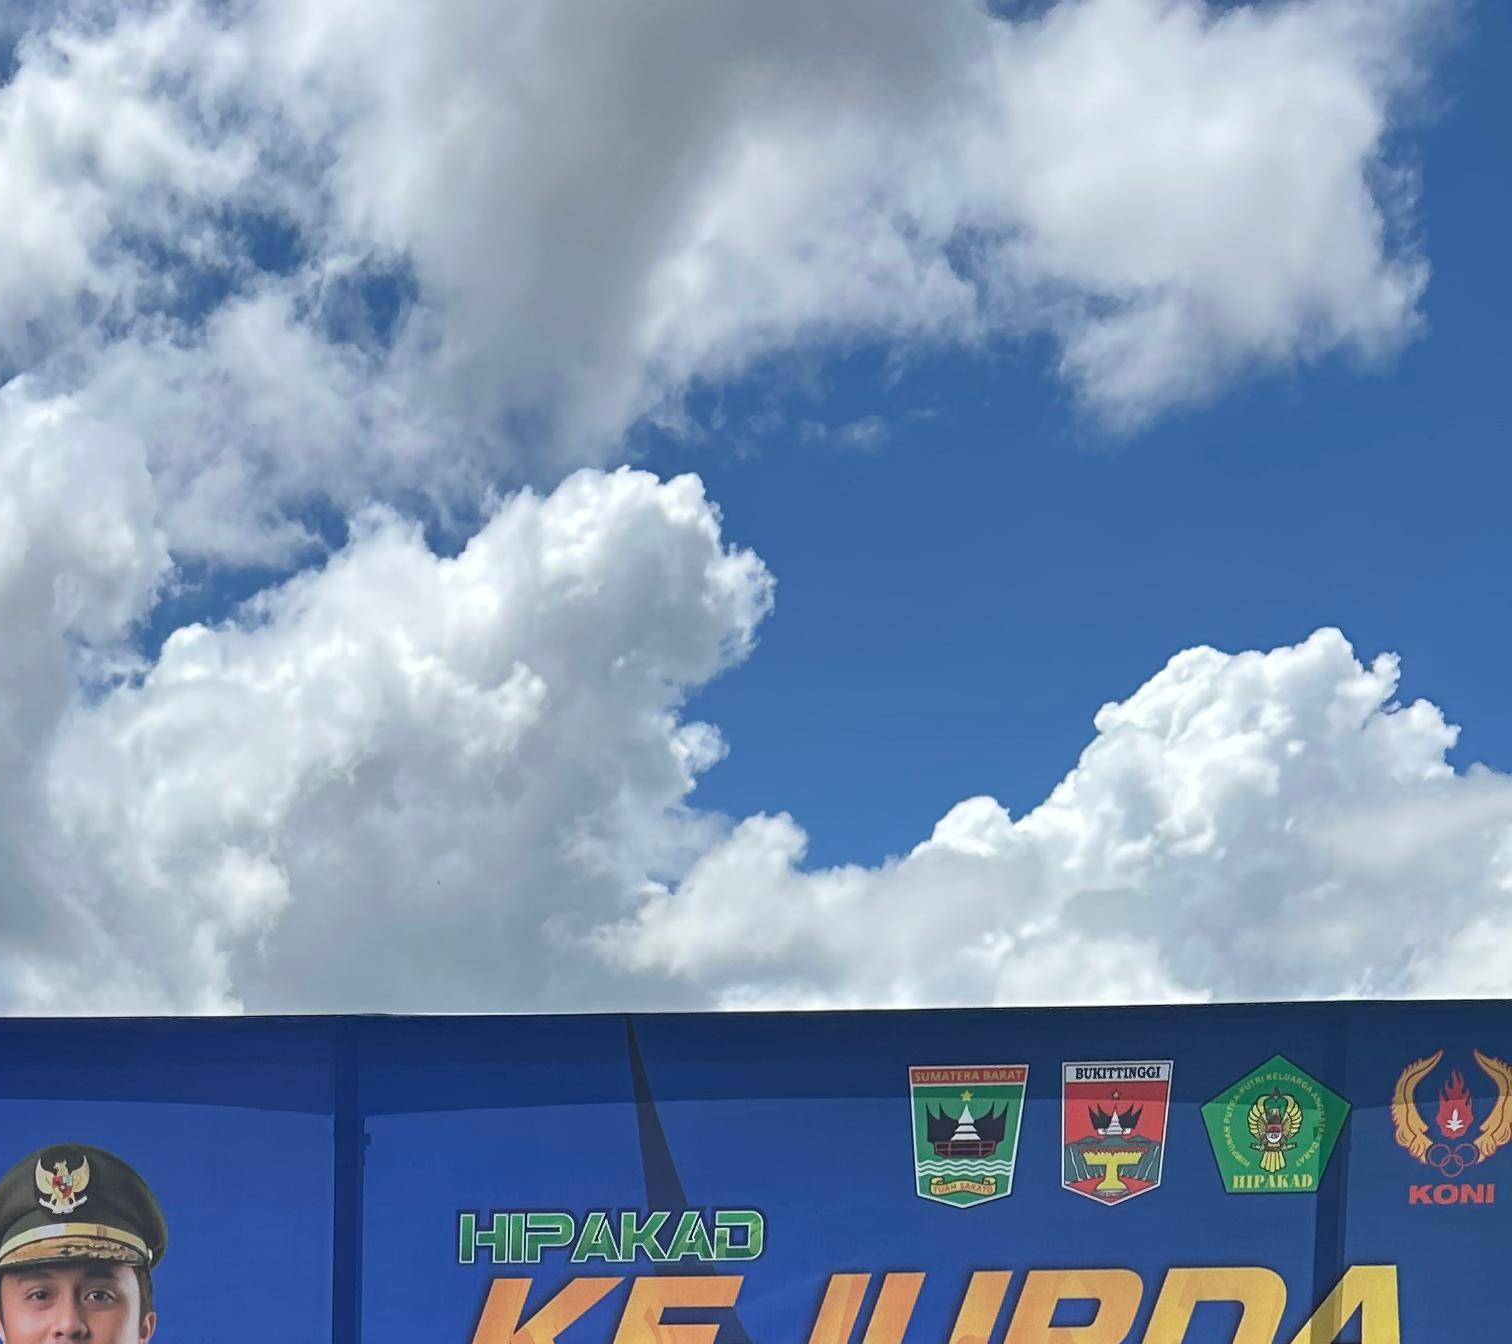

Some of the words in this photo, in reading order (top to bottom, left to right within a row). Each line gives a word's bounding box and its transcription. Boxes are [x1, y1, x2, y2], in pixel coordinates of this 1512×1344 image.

[914, 1071, 980, 1082] SUMATERA
[982, 1069, 1023, 1081] BARAT
[1074, 1066, 1162, 1080] BUKITTINGGI
[1232, 1173, 1314, 1190] HIPAKAD
[1408, 1183, 1496, 1206] KONI
[457, 1209, 766, 1264] HIPAKAD
